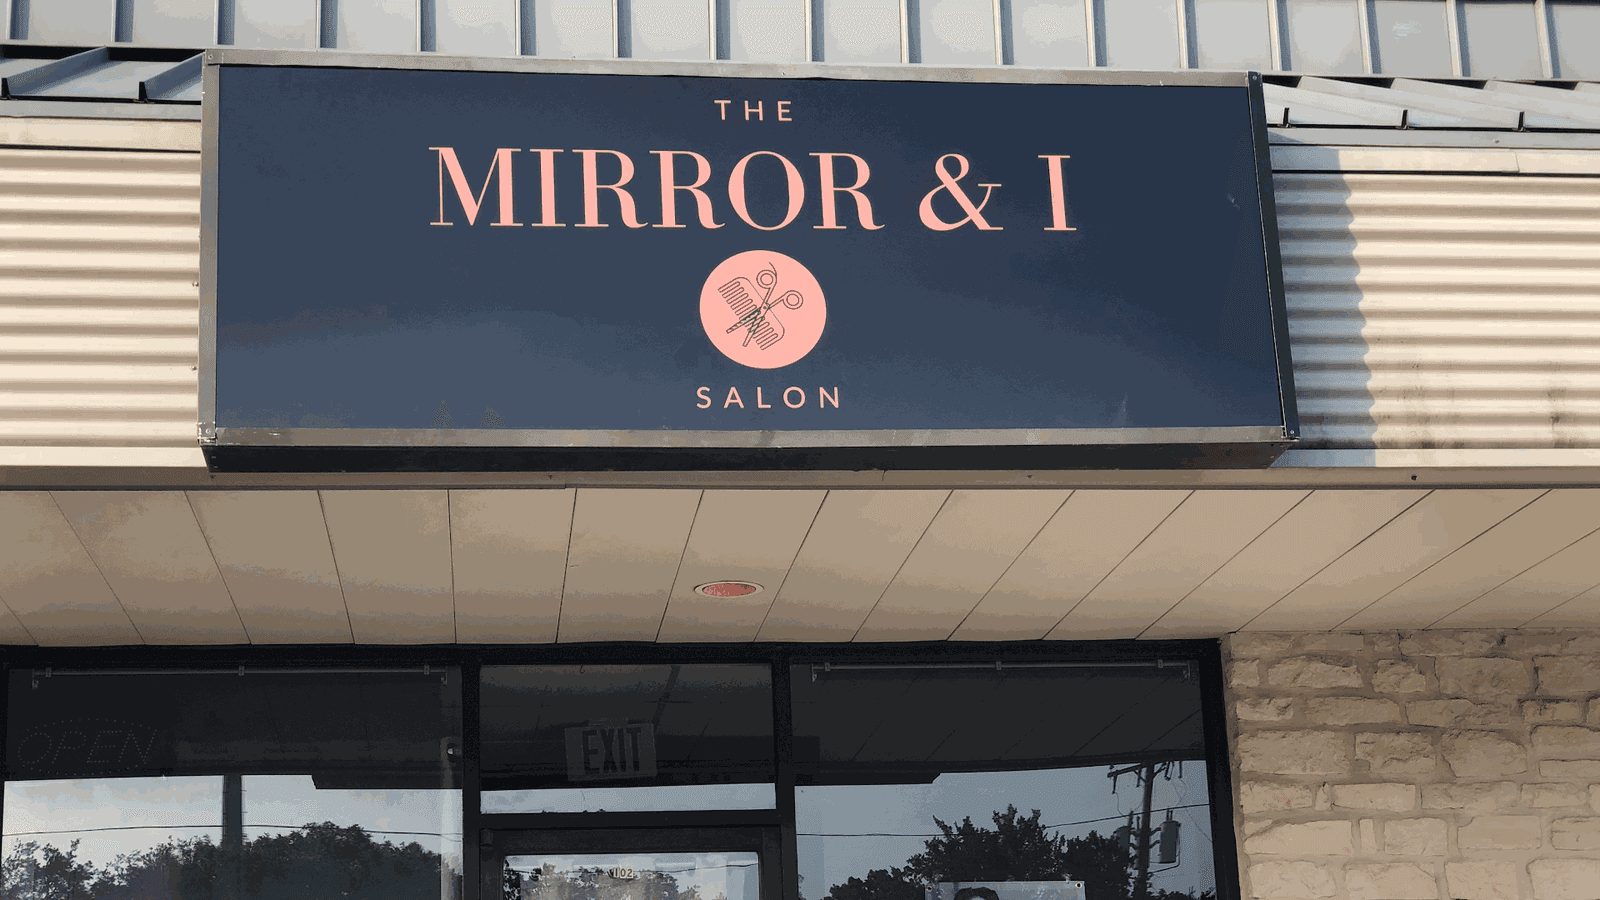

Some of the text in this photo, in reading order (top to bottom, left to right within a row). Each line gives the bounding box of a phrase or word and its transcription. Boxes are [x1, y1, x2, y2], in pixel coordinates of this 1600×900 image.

[714, 99, 792, 122] THE
[429, 146, 1077, 233] MIRROR & I
[696, 386, 839, 409] SALON
[17, 729, 158, 765] OPEN
[581, 727, 642, 775] EXIT
[614, 867, 633, 878] 102
